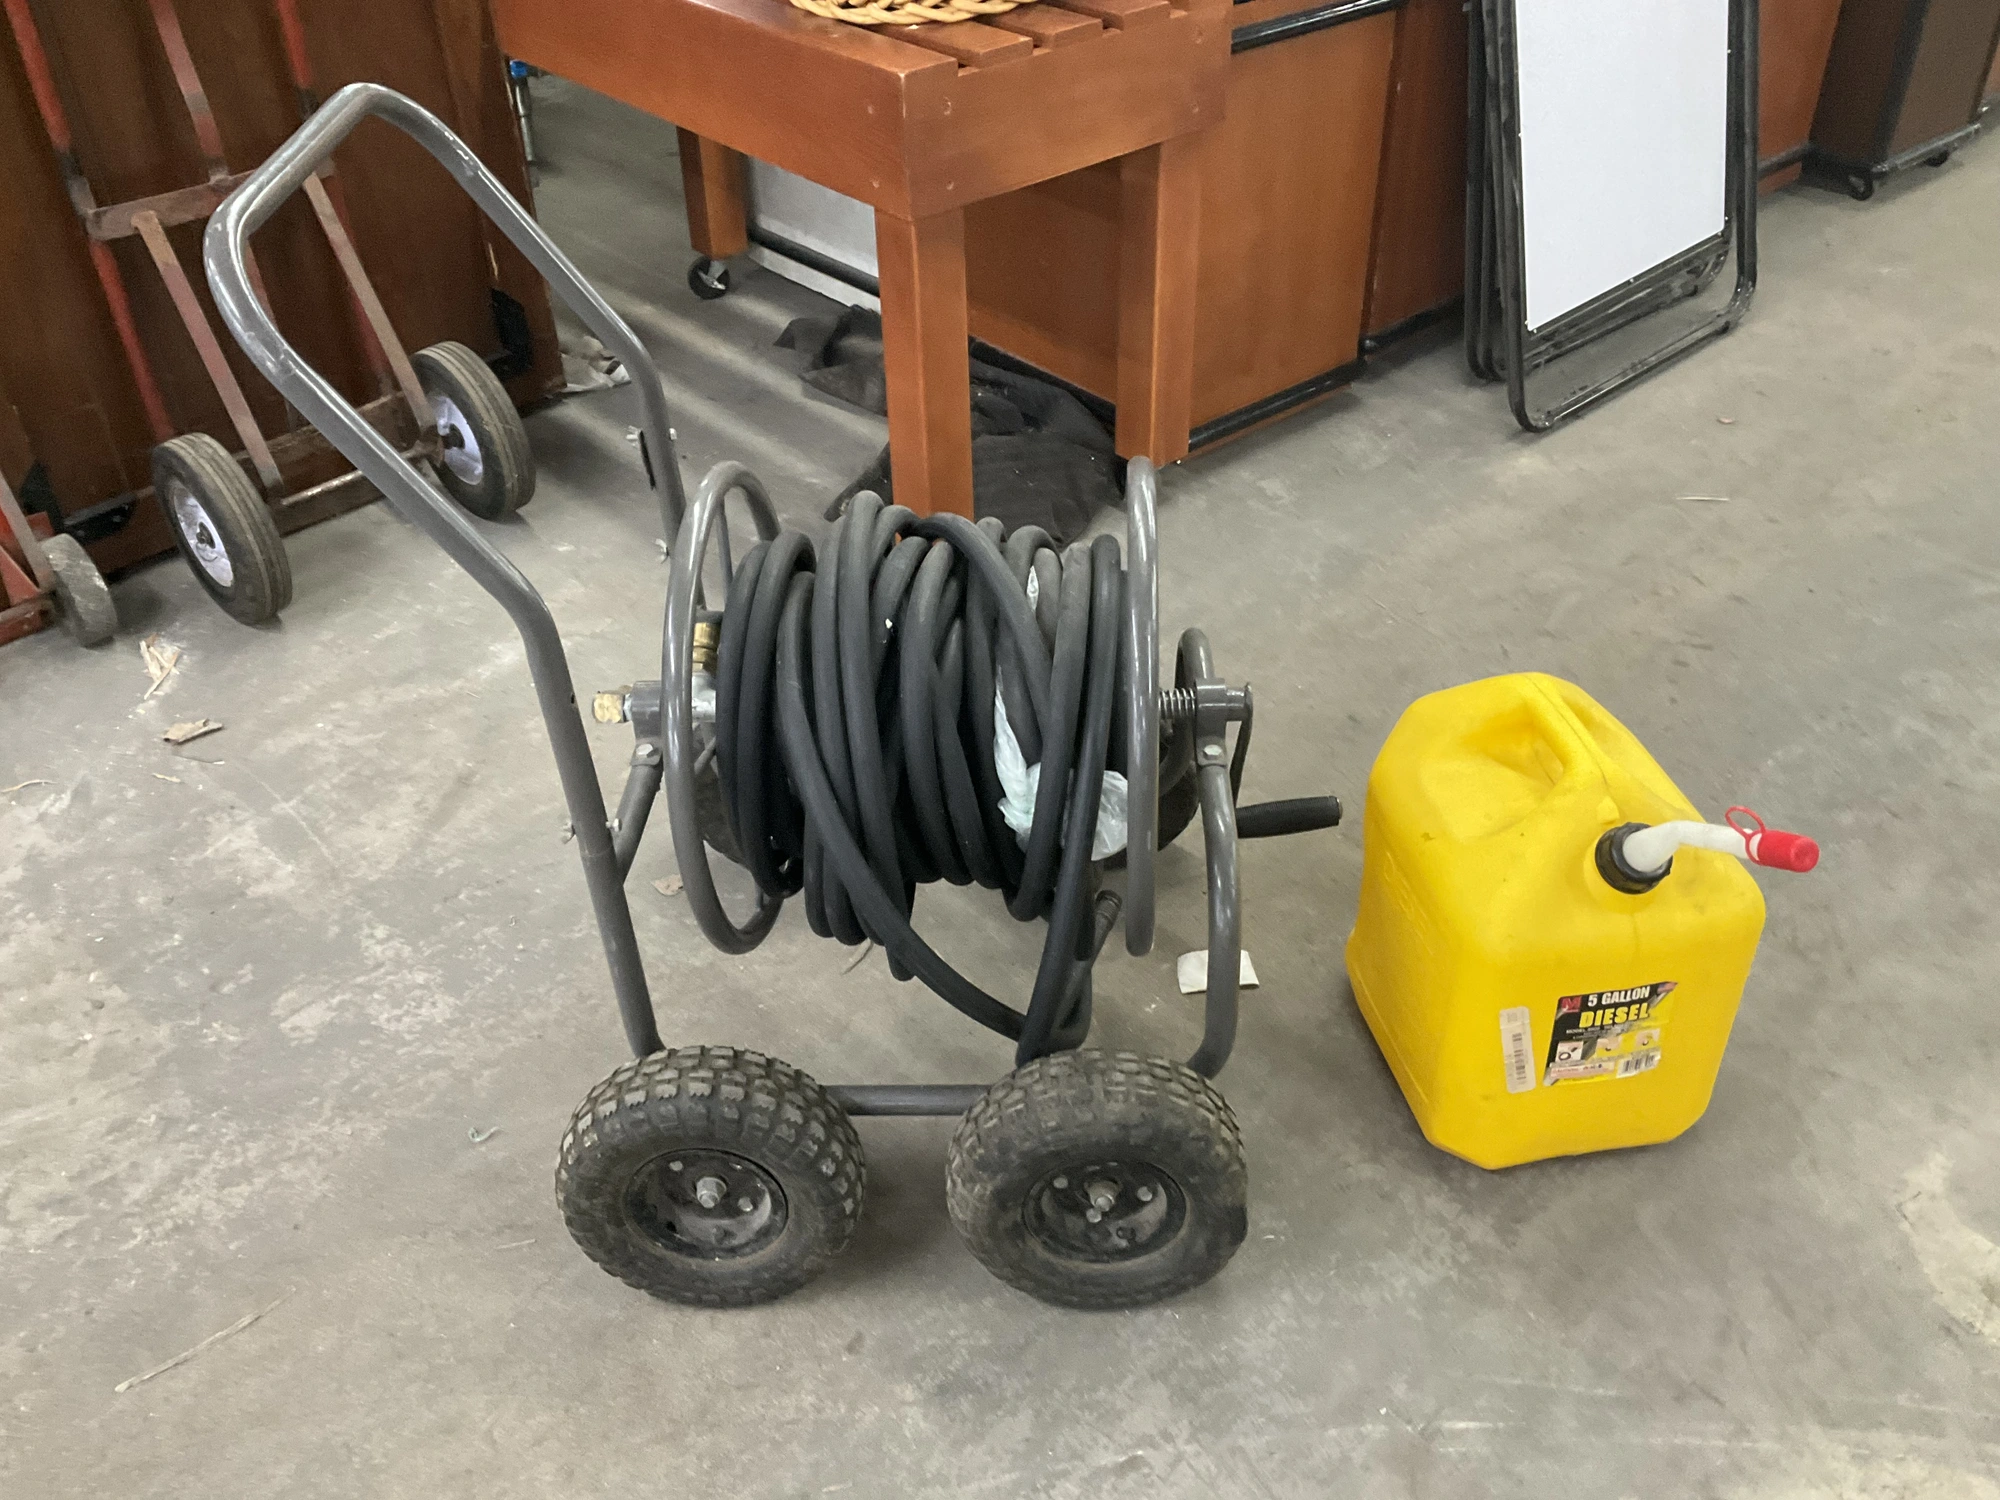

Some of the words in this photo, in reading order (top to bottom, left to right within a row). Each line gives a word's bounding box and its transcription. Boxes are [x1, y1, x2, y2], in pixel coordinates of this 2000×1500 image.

[1588, 994, 1598, 1007] 5
[1601, 985, 1650, 1005] GALLON
[1579, 1003, 1648, 1028] DIESEL
